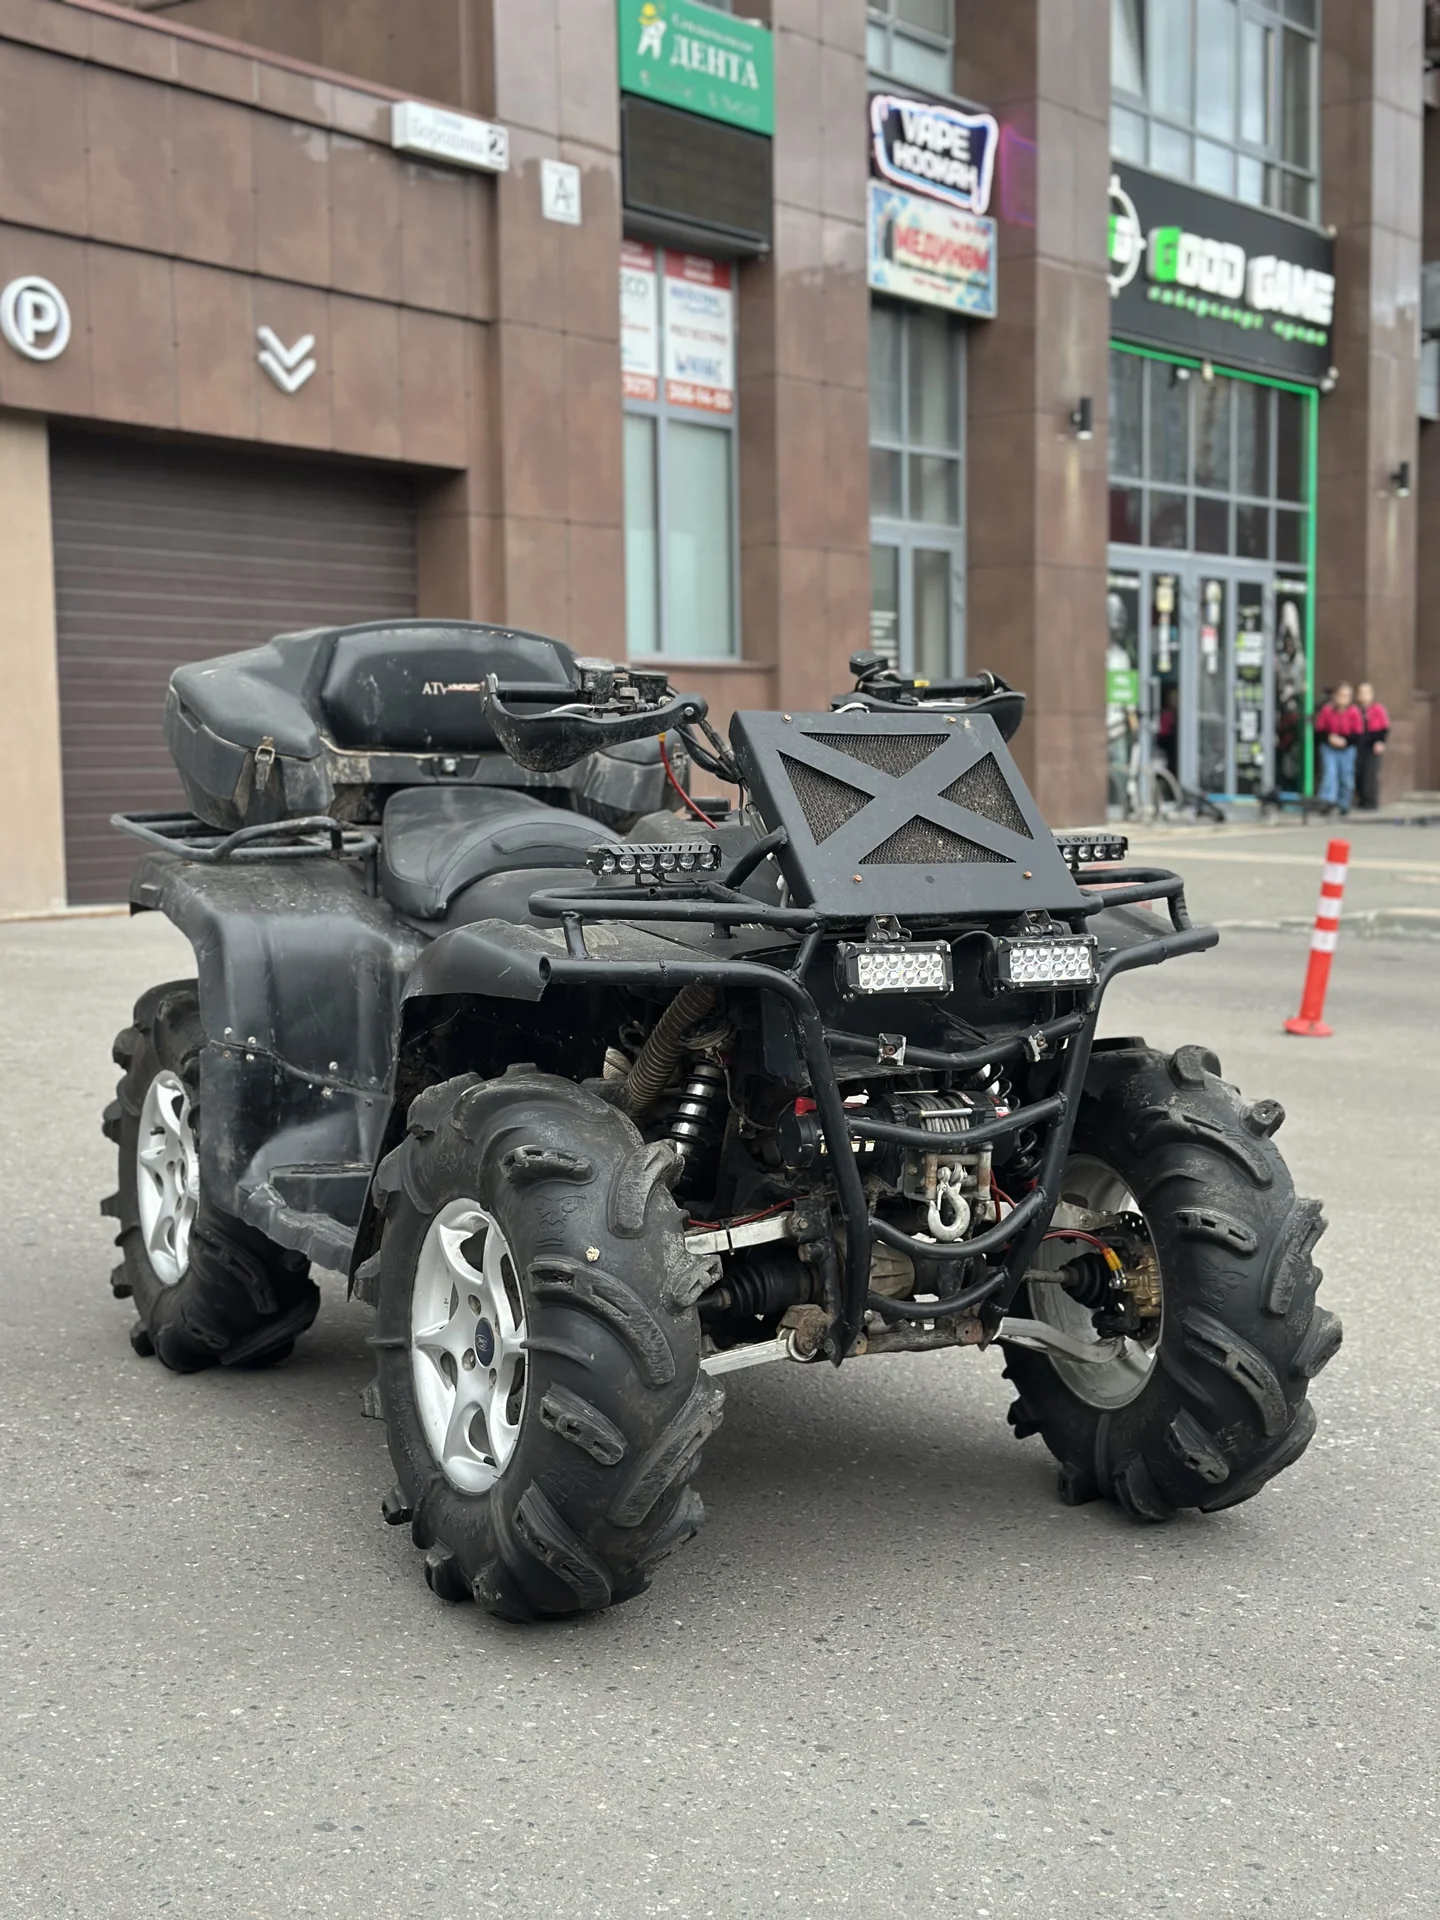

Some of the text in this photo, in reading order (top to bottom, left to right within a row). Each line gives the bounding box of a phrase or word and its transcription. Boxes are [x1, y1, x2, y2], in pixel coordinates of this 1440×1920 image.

[669, 33, 759, 91] ДЕНТА
[900, 110, 971, 162] VAPE
[893, 140, 978, 191] HOOKAH
[1147, 226, 1246, 300] GOOD
[1247, 254, 1336, 326] GAME
[19, 289, 59, 344] P
